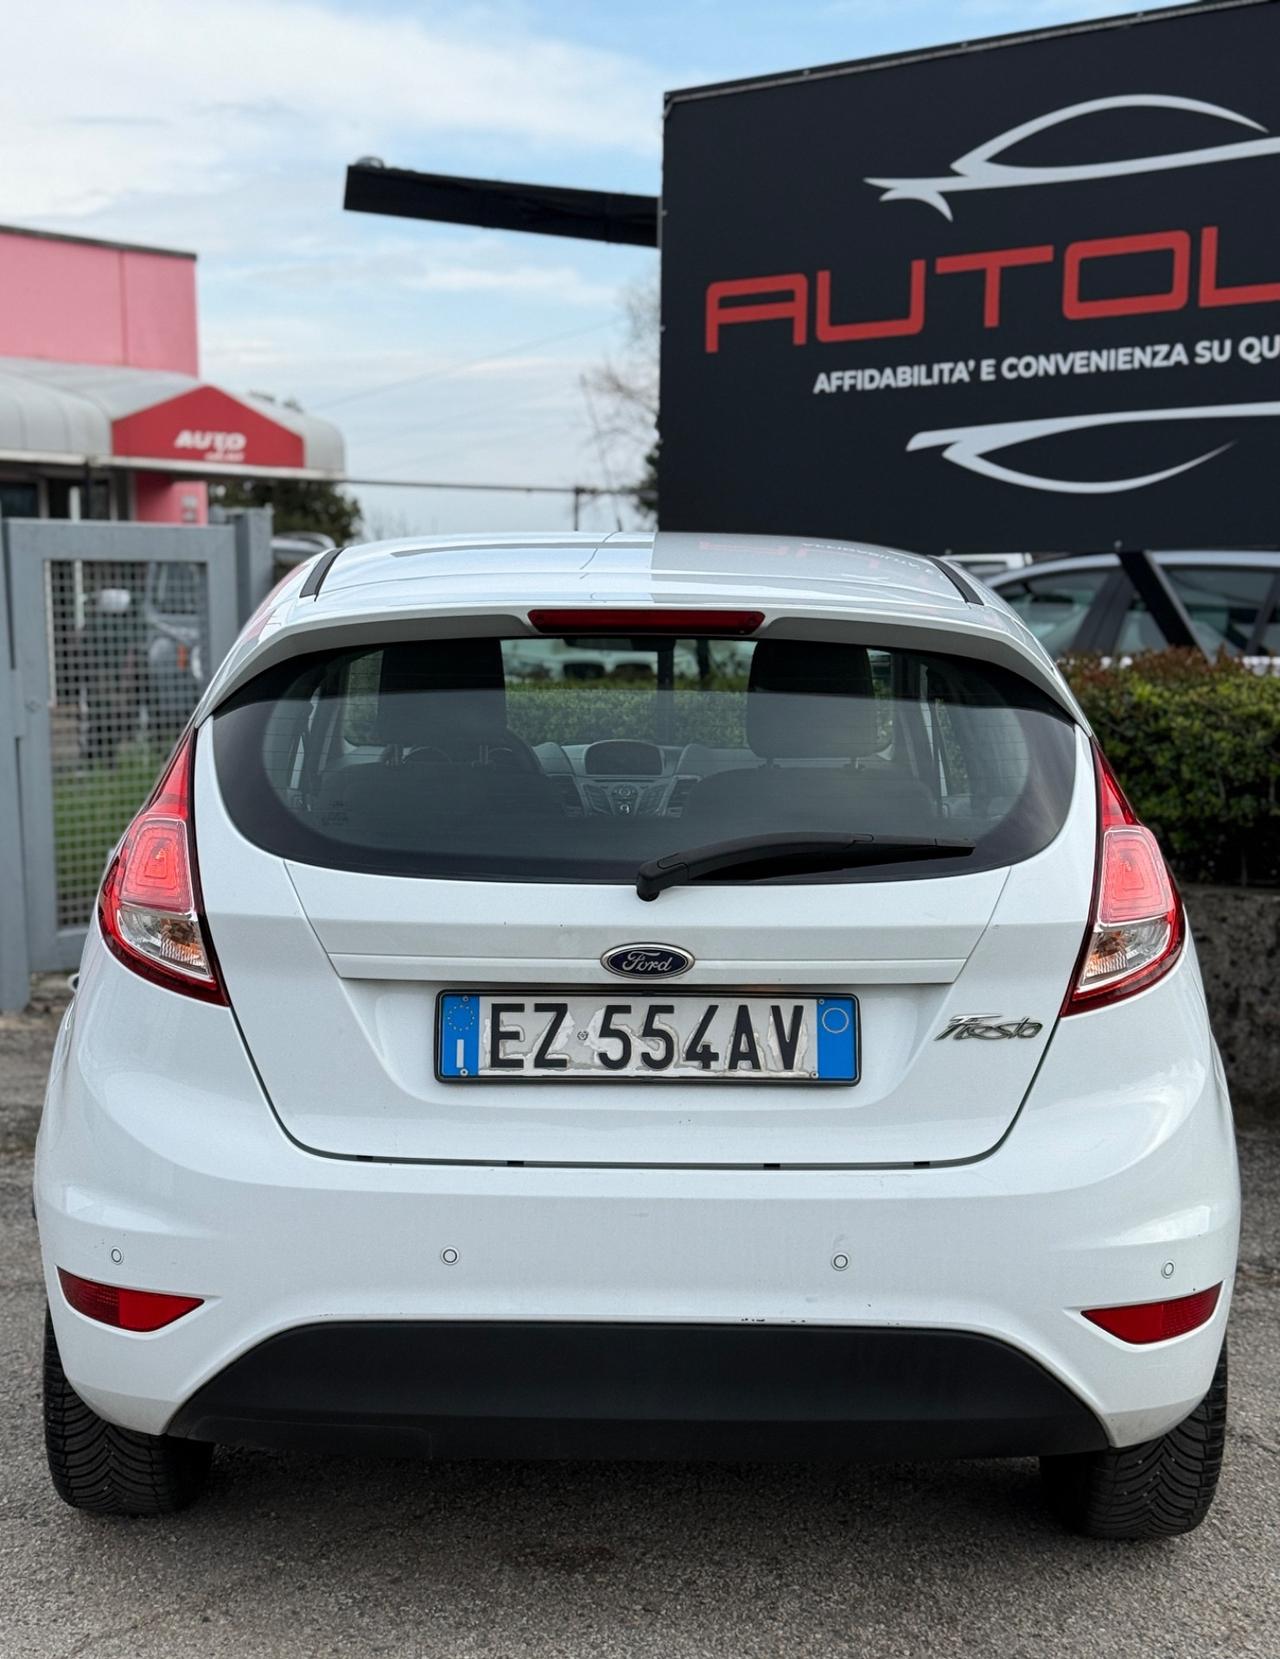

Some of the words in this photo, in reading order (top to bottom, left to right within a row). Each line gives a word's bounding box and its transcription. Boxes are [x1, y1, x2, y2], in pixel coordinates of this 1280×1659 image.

[813, 358, 976, 394] AFFIDABILITA'
[980, 358, 996, 381] E
[1001, 342, 1189, 379] CONVENIENZA
[1194, 338, 1232, 364] SU
[1238, 333, 1280, 364] QU
[174, 430, 247, 451] AUTO
[622, 951, 673, 971] Ford
[490, 1002, 568, 1068] EZ
[600, 1004, 804, 1070] 554AV
